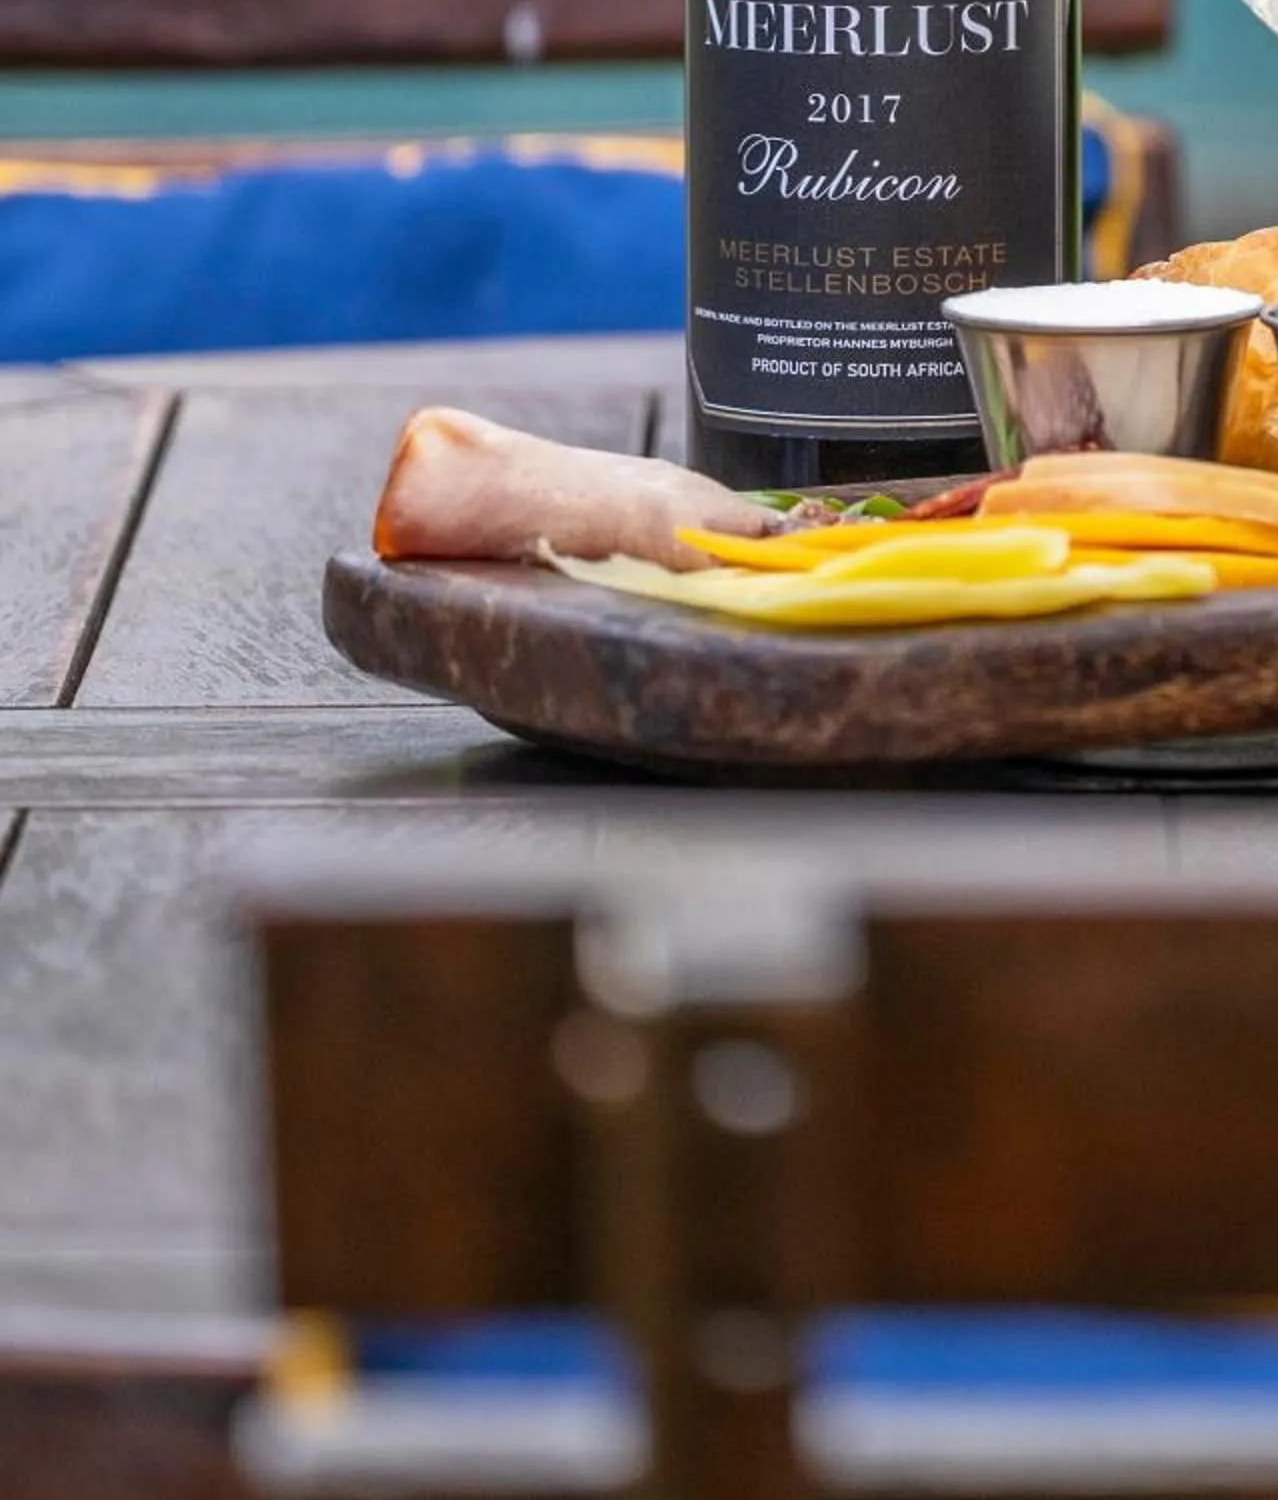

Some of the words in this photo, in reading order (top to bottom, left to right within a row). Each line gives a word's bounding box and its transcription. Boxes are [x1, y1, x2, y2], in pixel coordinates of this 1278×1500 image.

[807, 93, 902, 124] 2017
[737, 133, 963, 201] Rubicon
[720, 239, 876, 269] MEERLUST
[892, 242, 1008, 268] ESTATE
[735, 267, 987, 295] STELLENBOSCH
[719, 312, 741, 325] MADE
[742, 315, 763, 327] AND
[763, 318, 813, 330] BOTTLED
[813, 321, 833, 331] ON
[834, 321, 859, 331] THE
[860, 321, 924, 331] MEERLUST
[927, 321, 956, 331] ESTA
[757, 334, 830, 348] PROPRIETOR
[832, 339, 888, 349] HANNES
[889, 337, 954, 349] MYBURGH
[751, 357, 817, 377] PRODUCT
[821, 362, 843, 377] OF
[847, 362, 902, 377] SOUTH
[905, 361, 966, 377] AFRICA
